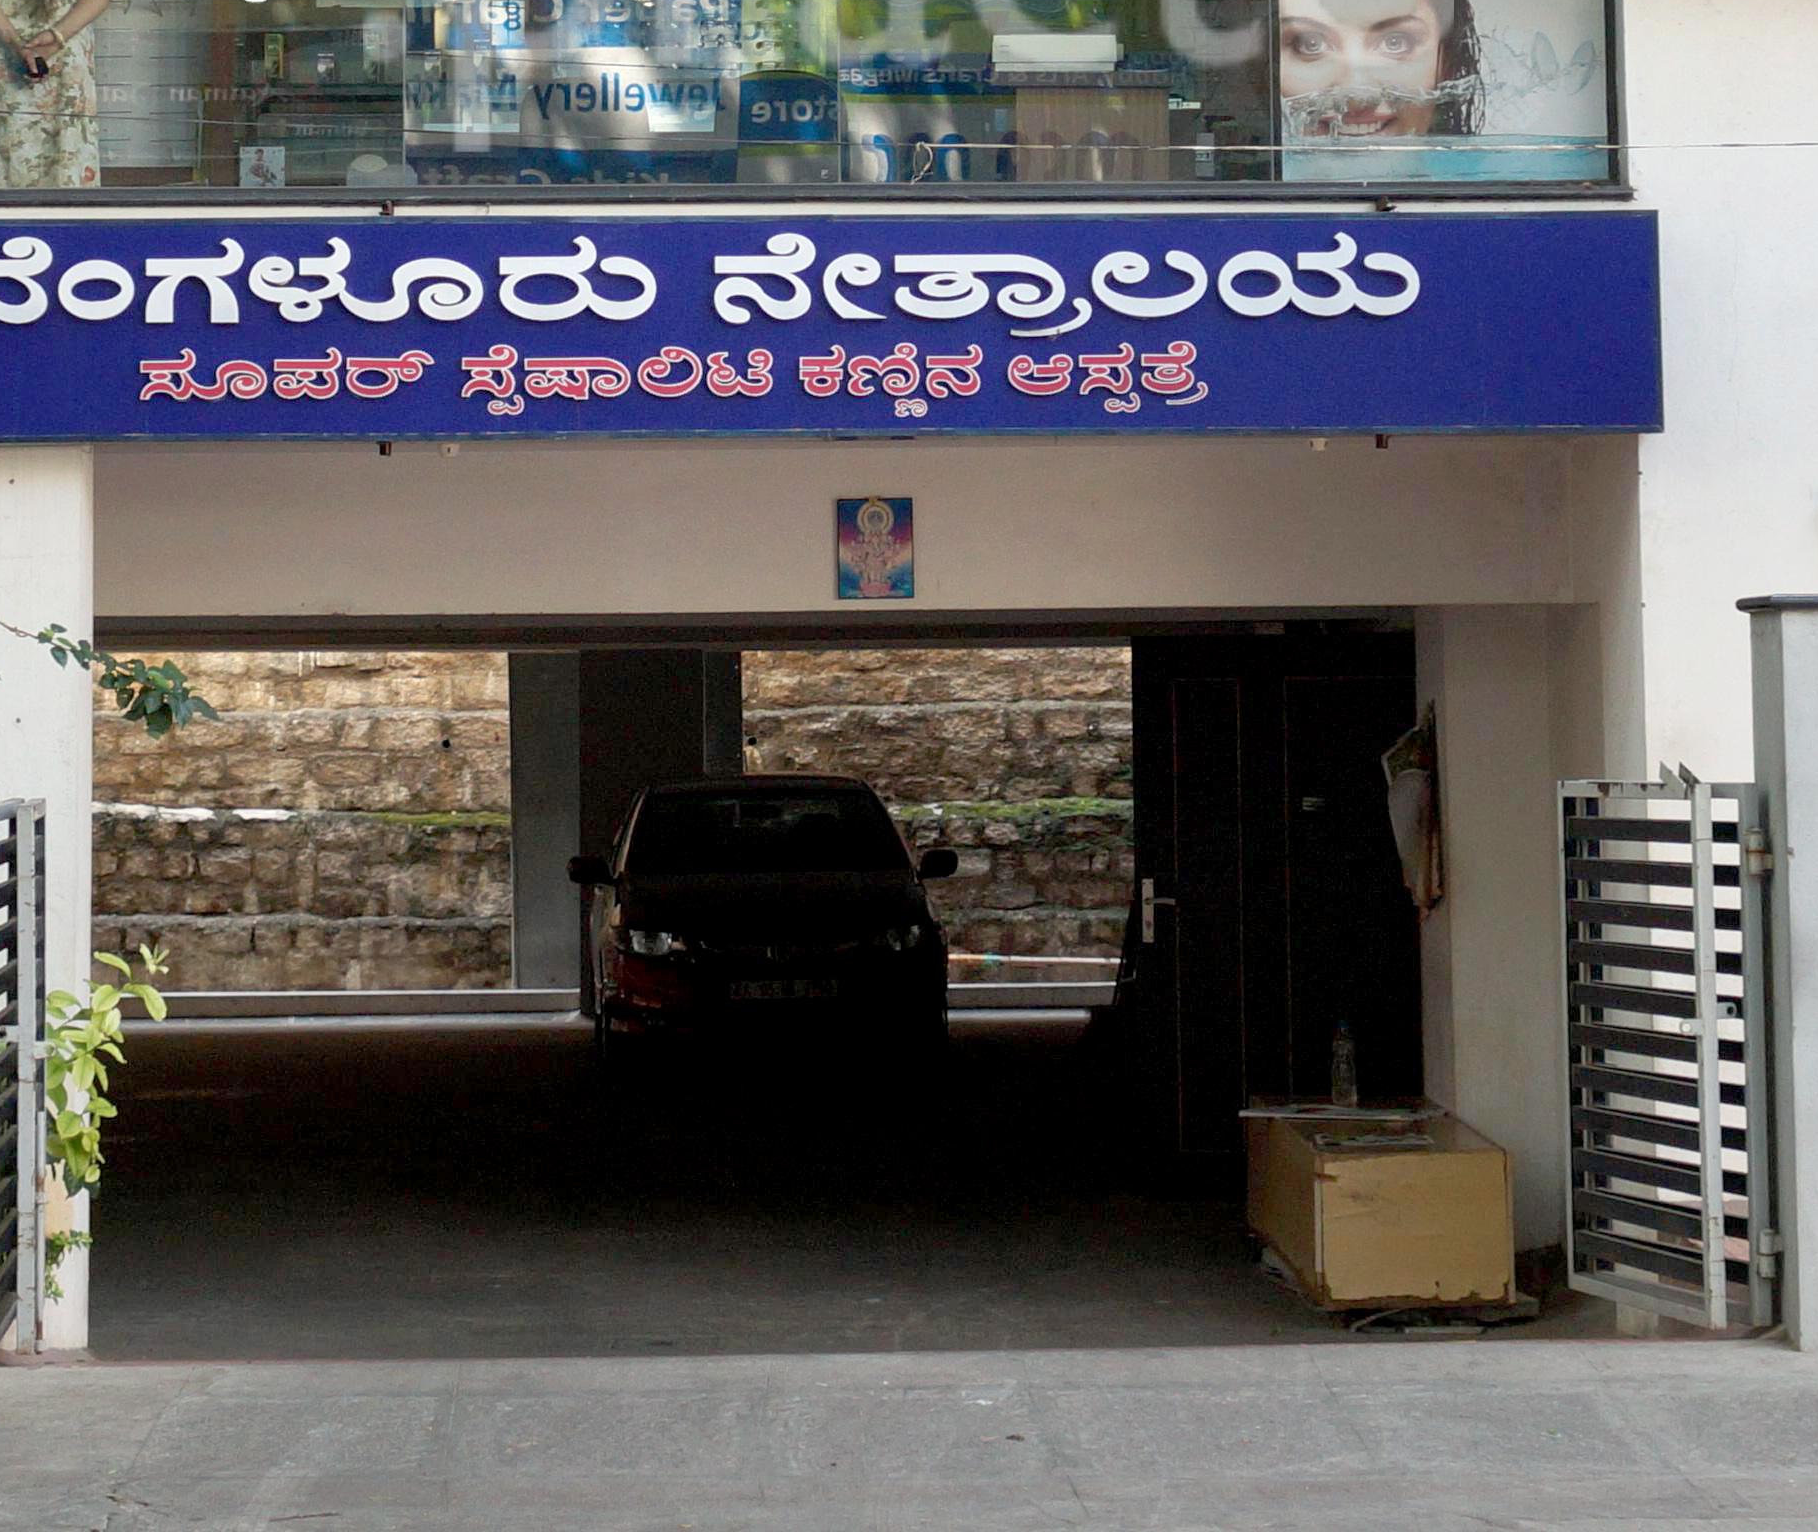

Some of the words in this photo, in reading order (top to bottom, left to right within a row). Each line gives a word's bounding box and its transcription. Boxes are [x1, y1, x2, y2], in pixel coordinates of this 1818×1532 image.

[713, 231, 1421, 338] ನೇತ್ರಾಲಯ
[138, 346, 436, 403] ಸೂಪರ್
[796, 341, 982, 419] ಕಣ್ಣಿನ
[1006, 340, 1211, 418] ಆಸ್ಪತ್ರೆ
